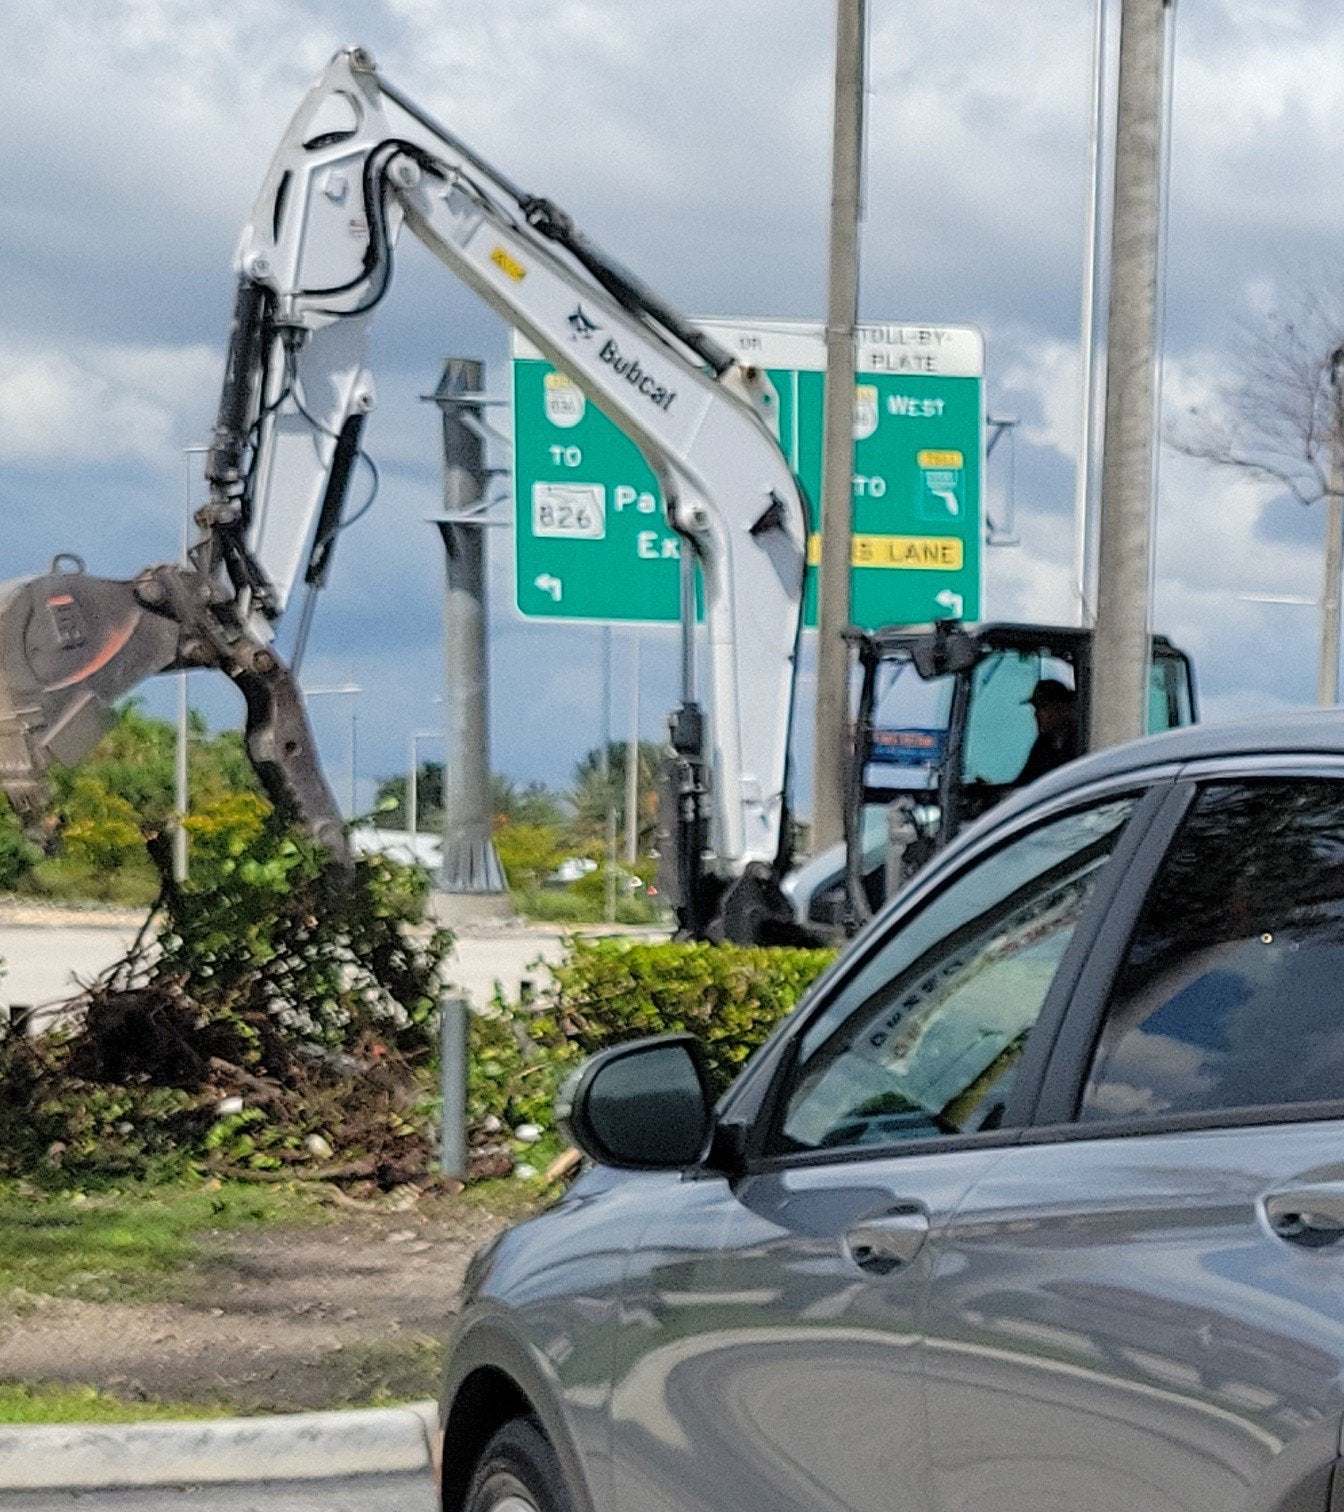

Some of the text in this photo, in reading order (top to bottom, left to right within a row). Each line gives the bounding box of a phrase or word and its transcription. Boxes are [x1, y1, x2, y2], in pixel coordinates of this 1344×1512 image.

[887, 394, 945, 417] WEST
[549, 444, 582, 467] TO
[852, 474, 886, 497] TO
[614, 485, 656, 513] Pa
[540, 505, 592, 529] 826
[638, 530, 680, 559] Ex
[889, 543, 954, 564] LANE
